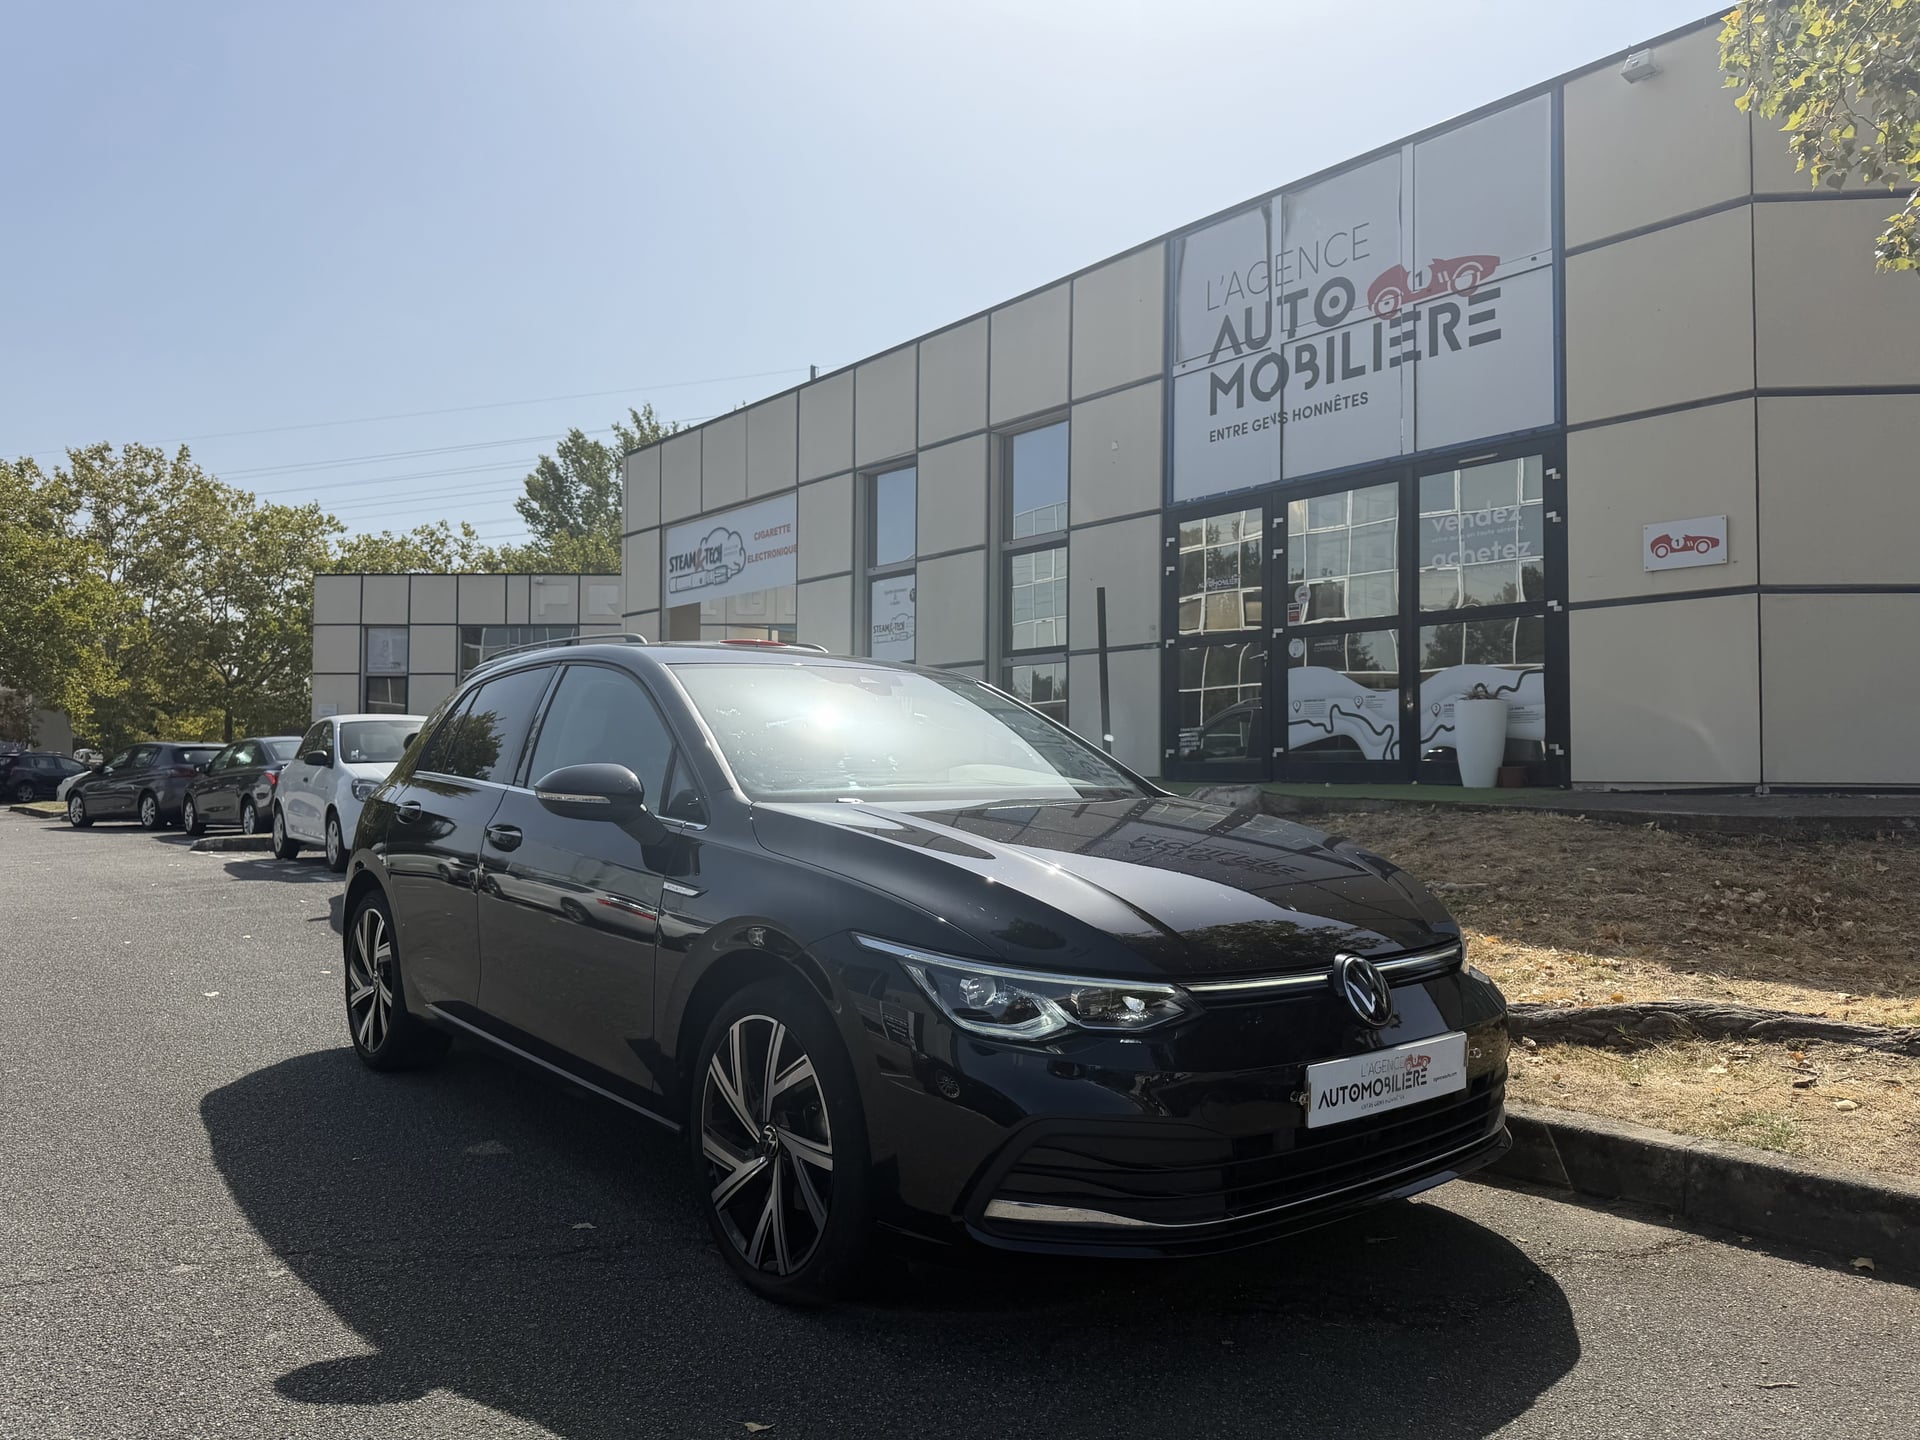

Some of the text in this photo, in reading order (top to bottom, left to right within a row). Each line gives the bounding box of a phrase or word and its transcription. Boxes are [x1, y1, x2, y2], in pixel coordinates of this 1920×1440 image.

[1207, 222, 1370, 311] L'AGENCE
[1207, 276, 1356, 364] AUTO
[1209, 286, 1502, 416] MOBILIERE
[1209, 391, 1369, 443] ENTRE GENS HONNÊTES
[753, 523, 792, 541] CIGARETTE
[1431, 500, 1522, 533] vendez
[1431, 540, 1532, 567] achetez
[1318, 1067, 1428, 1110] AUTOMOBILIERE
